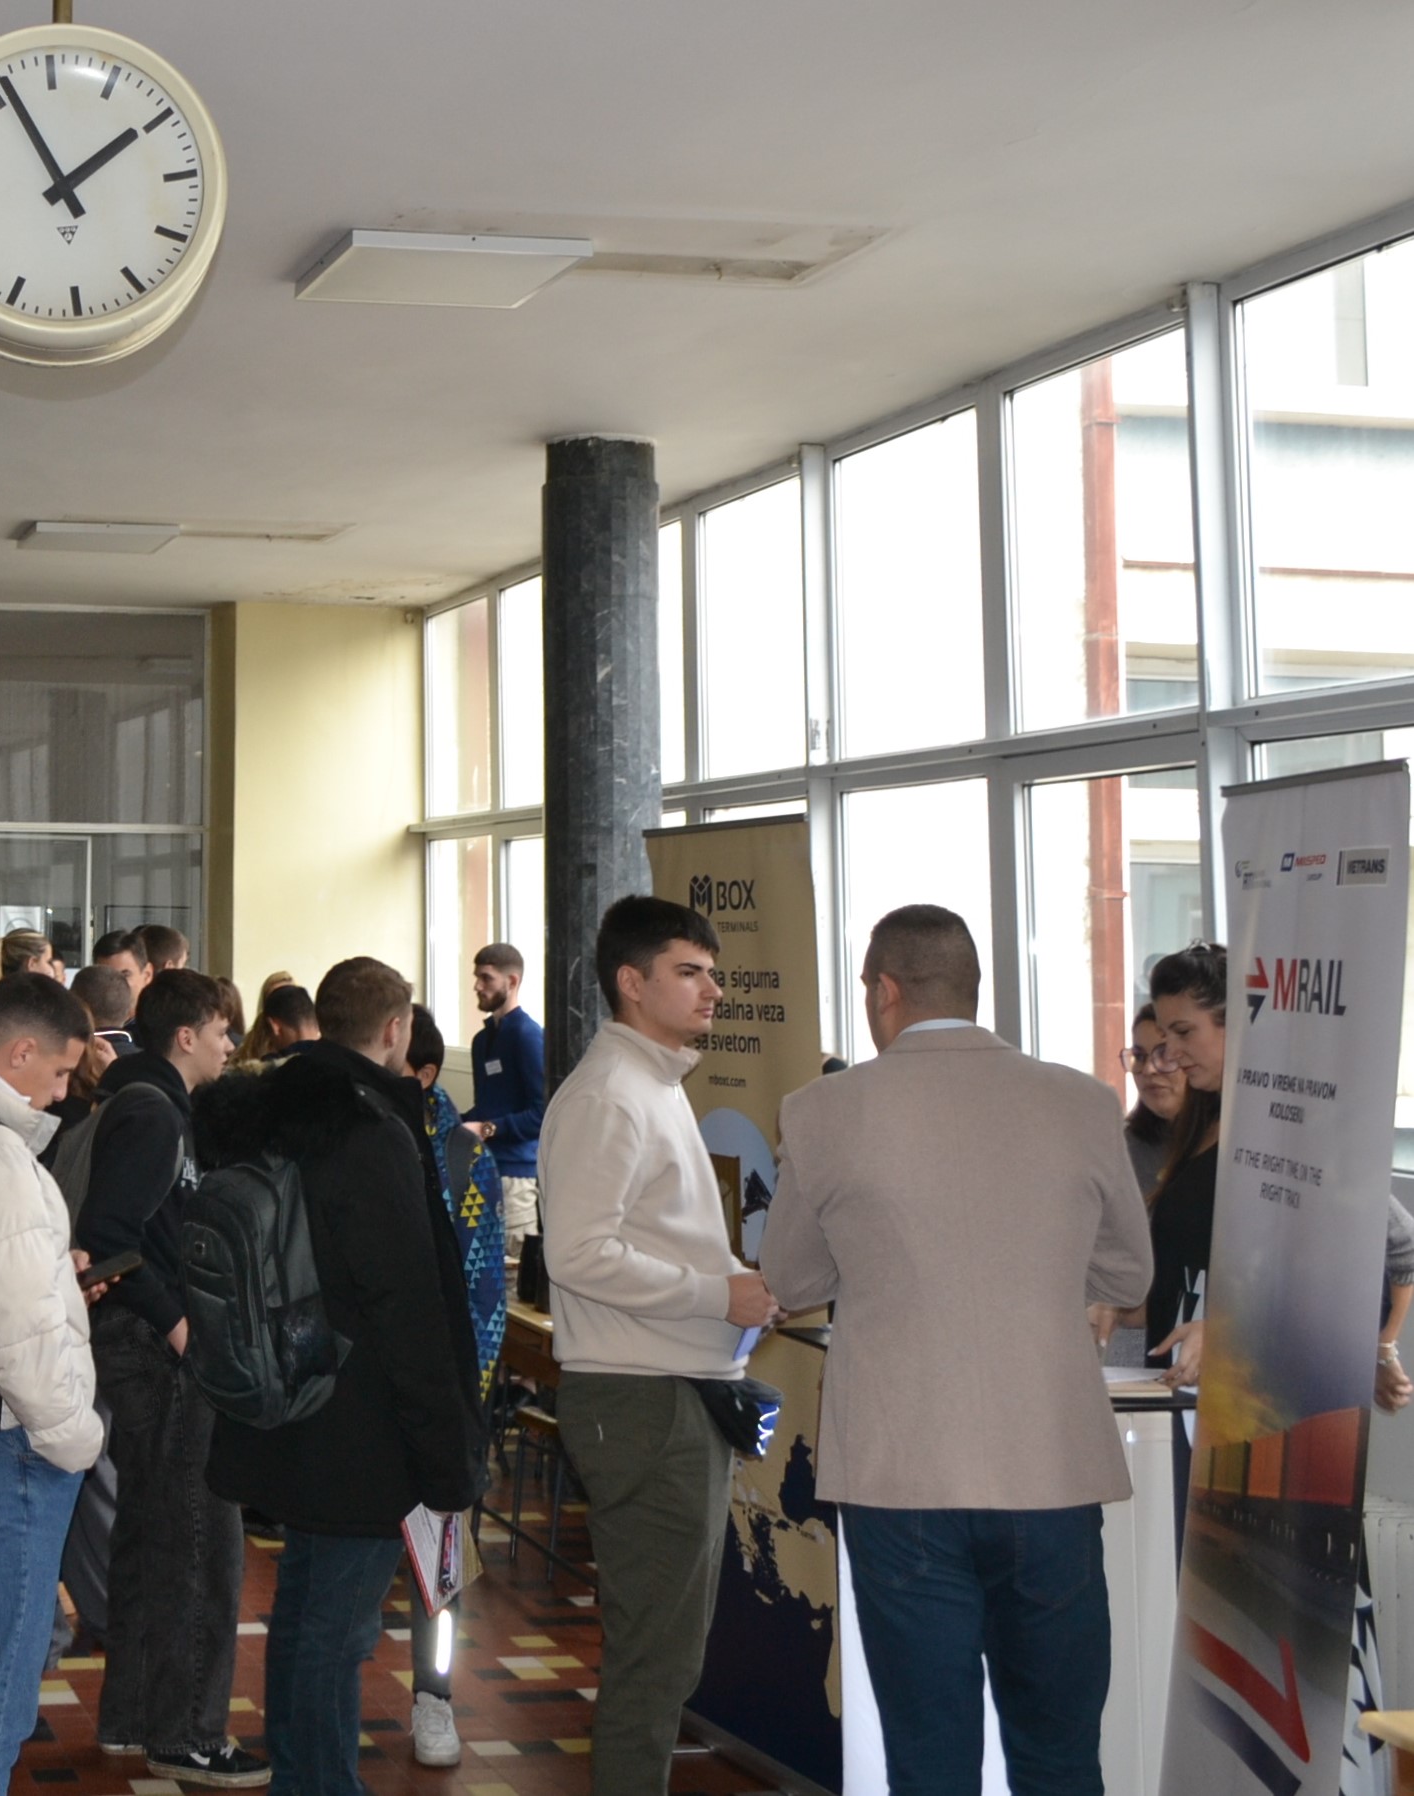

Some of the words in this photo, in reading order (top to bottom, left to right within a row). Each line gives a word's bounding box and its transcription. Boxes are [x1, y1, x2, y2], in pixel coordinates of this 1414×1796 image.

[717, 921, 759, 933] TERMINALS
[1273, 958, 1347, 1016] MRAIL
[756, 1005, 785, 1023] veza
[711, 1033, 761, 1054] svetom
[1242, 1069, 1270, 1089] PRAVO
[1272, 1074, 1297, 1094] VREME
[1305, 1079, 1337, 1101] PRAVOM
[1234, 1147, 1244, 1164] AT
[1245, 1149, 1261, 1169] THE
[1261, 1153, 1286, 1175] RIGHT
[1308, 1166, 1323, 1187] THE
[1260, 1182, 1284, 1203] RIGHT
